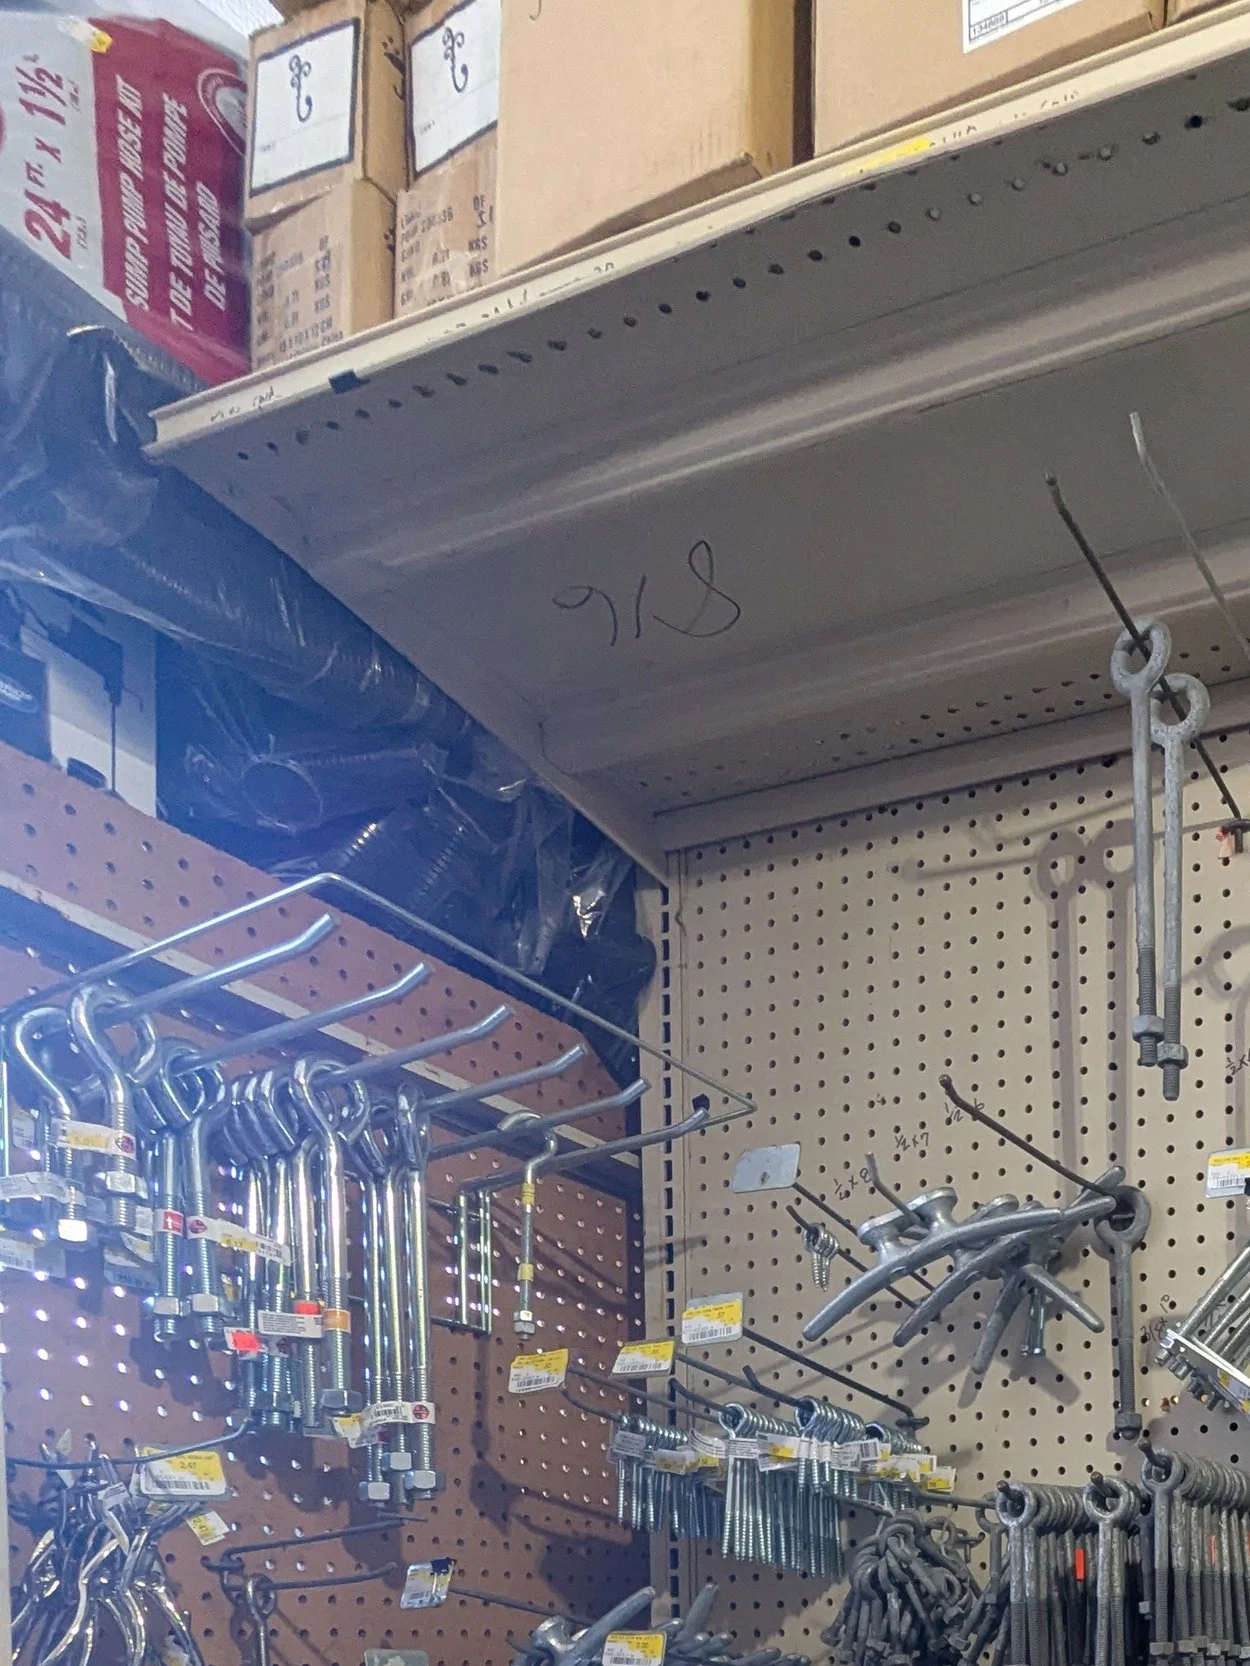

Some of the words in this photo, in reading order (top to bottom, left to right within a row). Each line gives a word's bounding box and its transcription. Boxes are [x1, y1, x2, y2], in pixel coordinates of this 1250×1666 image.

[114, 73, 144, 120] KIT
[115, 109, 145, 182] HOSE
[162, 92, 190, 180] POMPE
[119, 172, 149, 245] PUMP
[163, 169, 190, 206] DE
[24, 188, 72, 260] 24
[125, 236, 150, 313] SUMP
[168, 271, 194, 304] DE
[203, 278, 227, 312] DE
